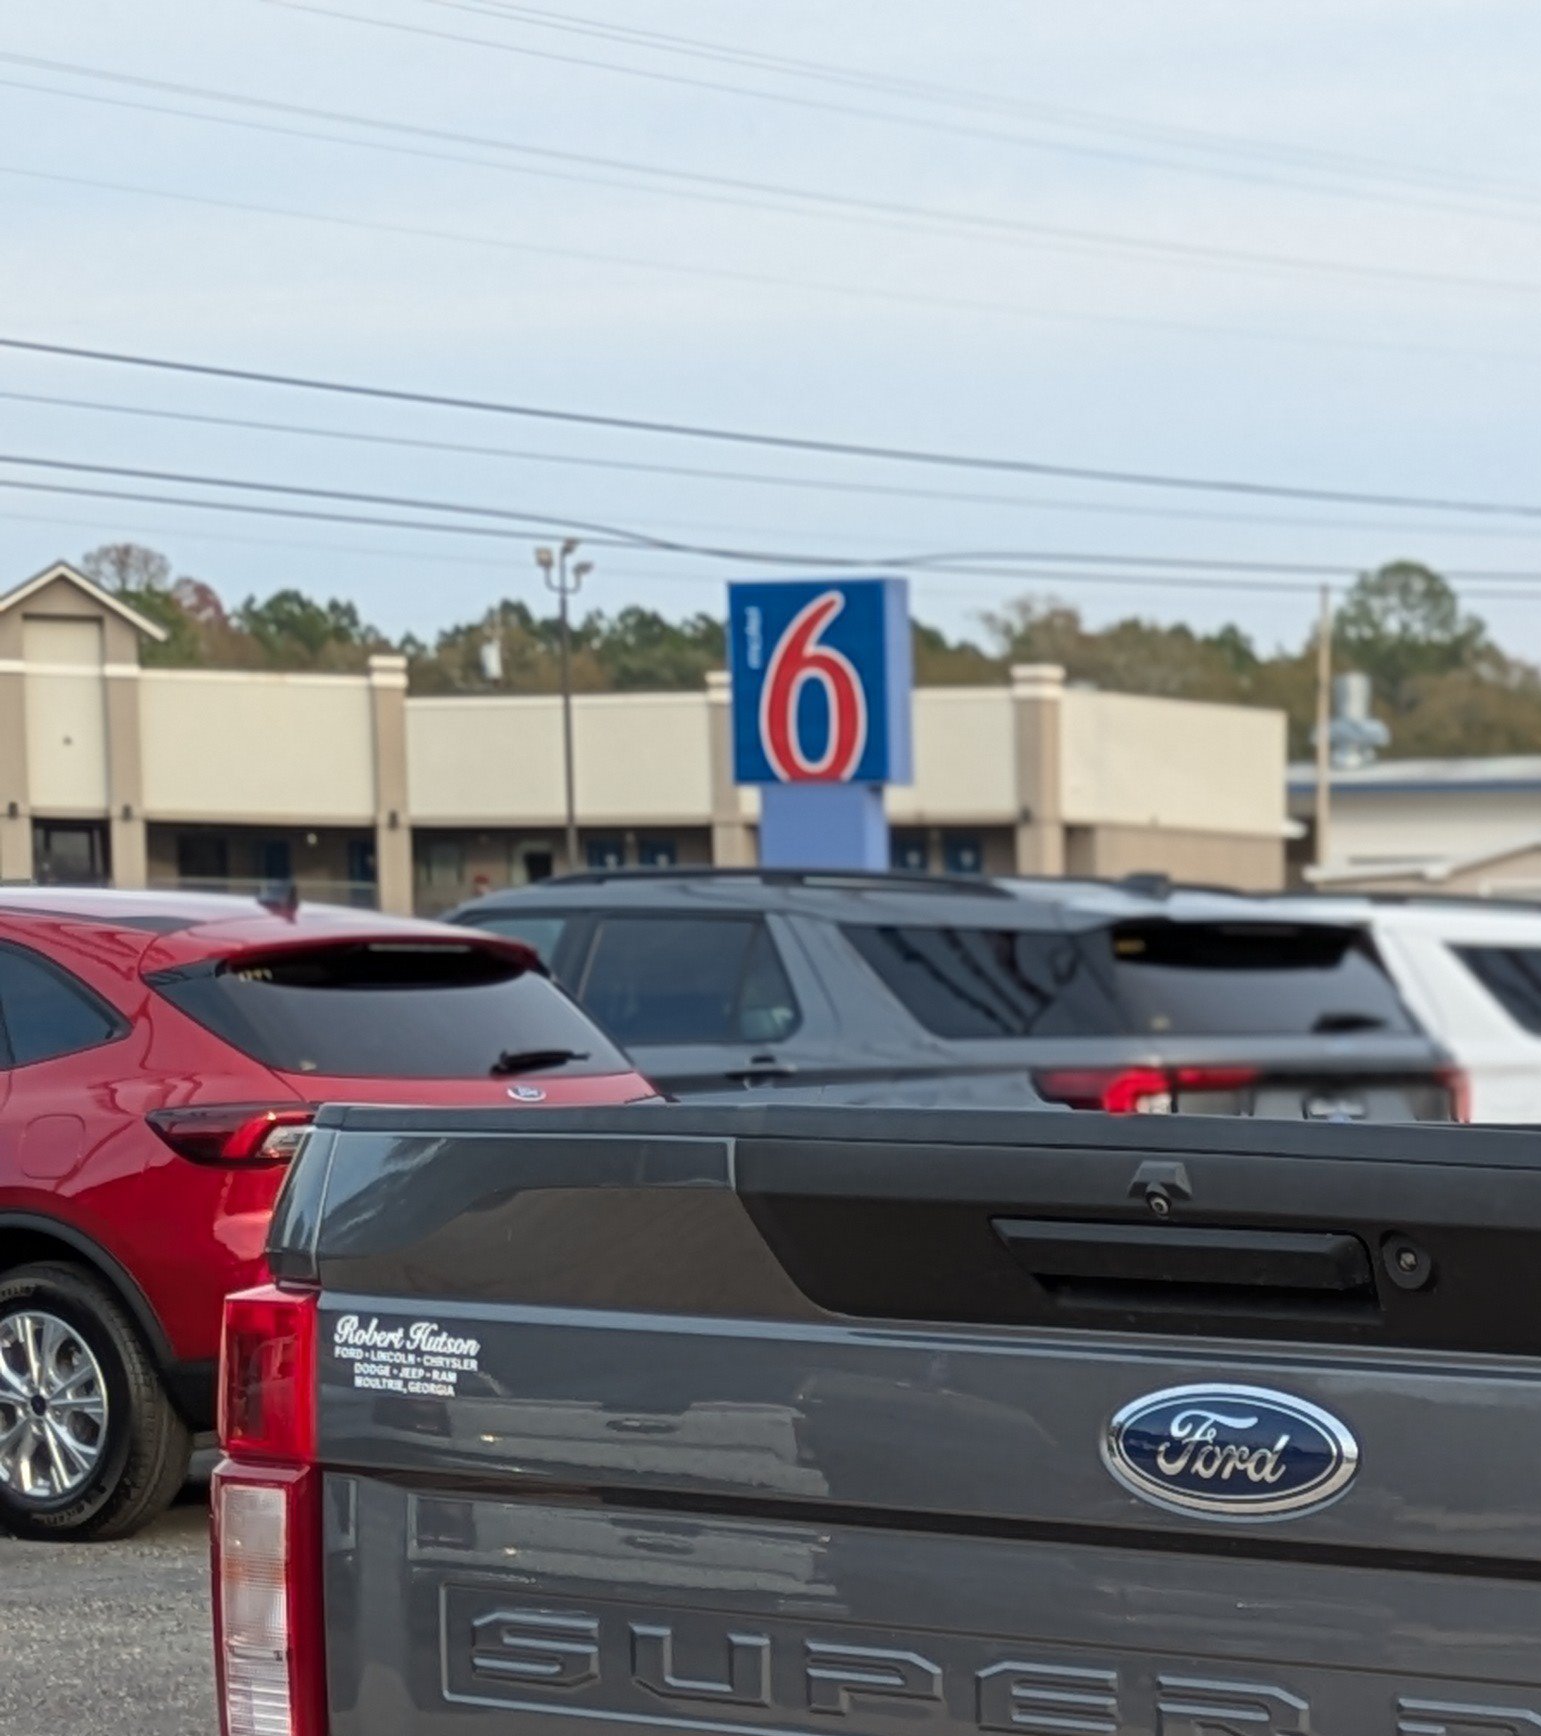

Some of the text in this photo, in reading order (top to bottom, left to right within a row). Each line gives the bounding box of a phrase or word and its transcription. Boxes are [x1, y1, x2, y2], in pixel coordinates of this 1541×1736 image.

[759, 589, 868, 782] 6
[333, 1315, 481, 1356] Robert Hutson
[334, 1346, 478, 1371] FORD LINCOLN CHRYSLER
[354, 1363, 457, 1383] DODGE JEEP RAM
[1156, 1409, 1291, 1484] Ford
